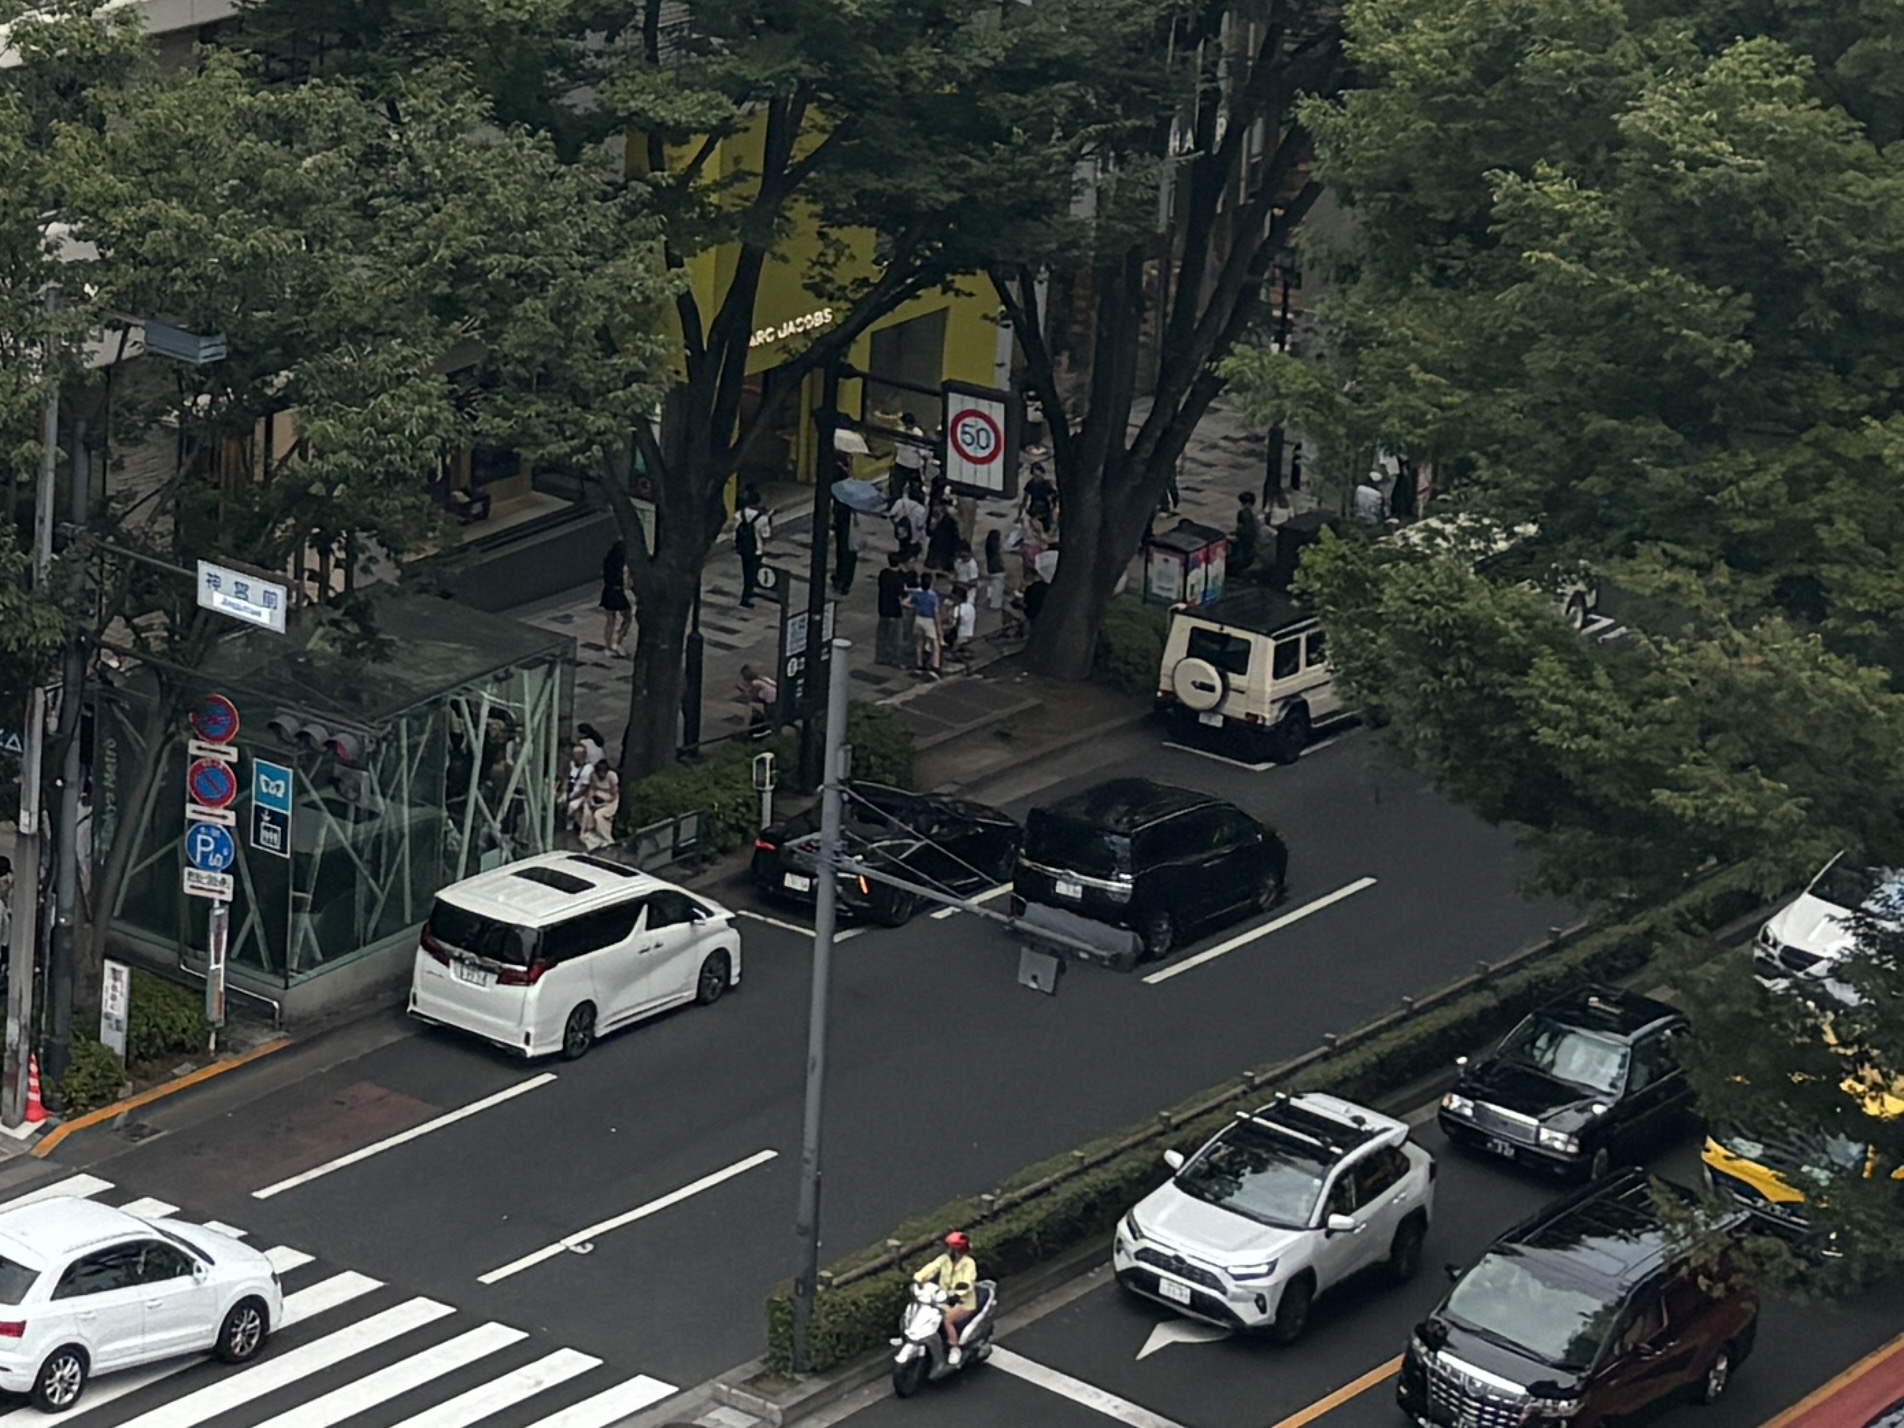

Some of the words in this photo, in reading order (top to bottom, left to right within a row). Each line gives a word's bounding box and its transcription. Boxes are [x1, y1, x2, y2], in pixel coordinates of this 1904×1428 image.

[748, 327, 775, 347] ARC
[777, 307, 833, 339] JACOBS
[961, 423, 992, 450] 50
[196, 834, 215, 864] P
